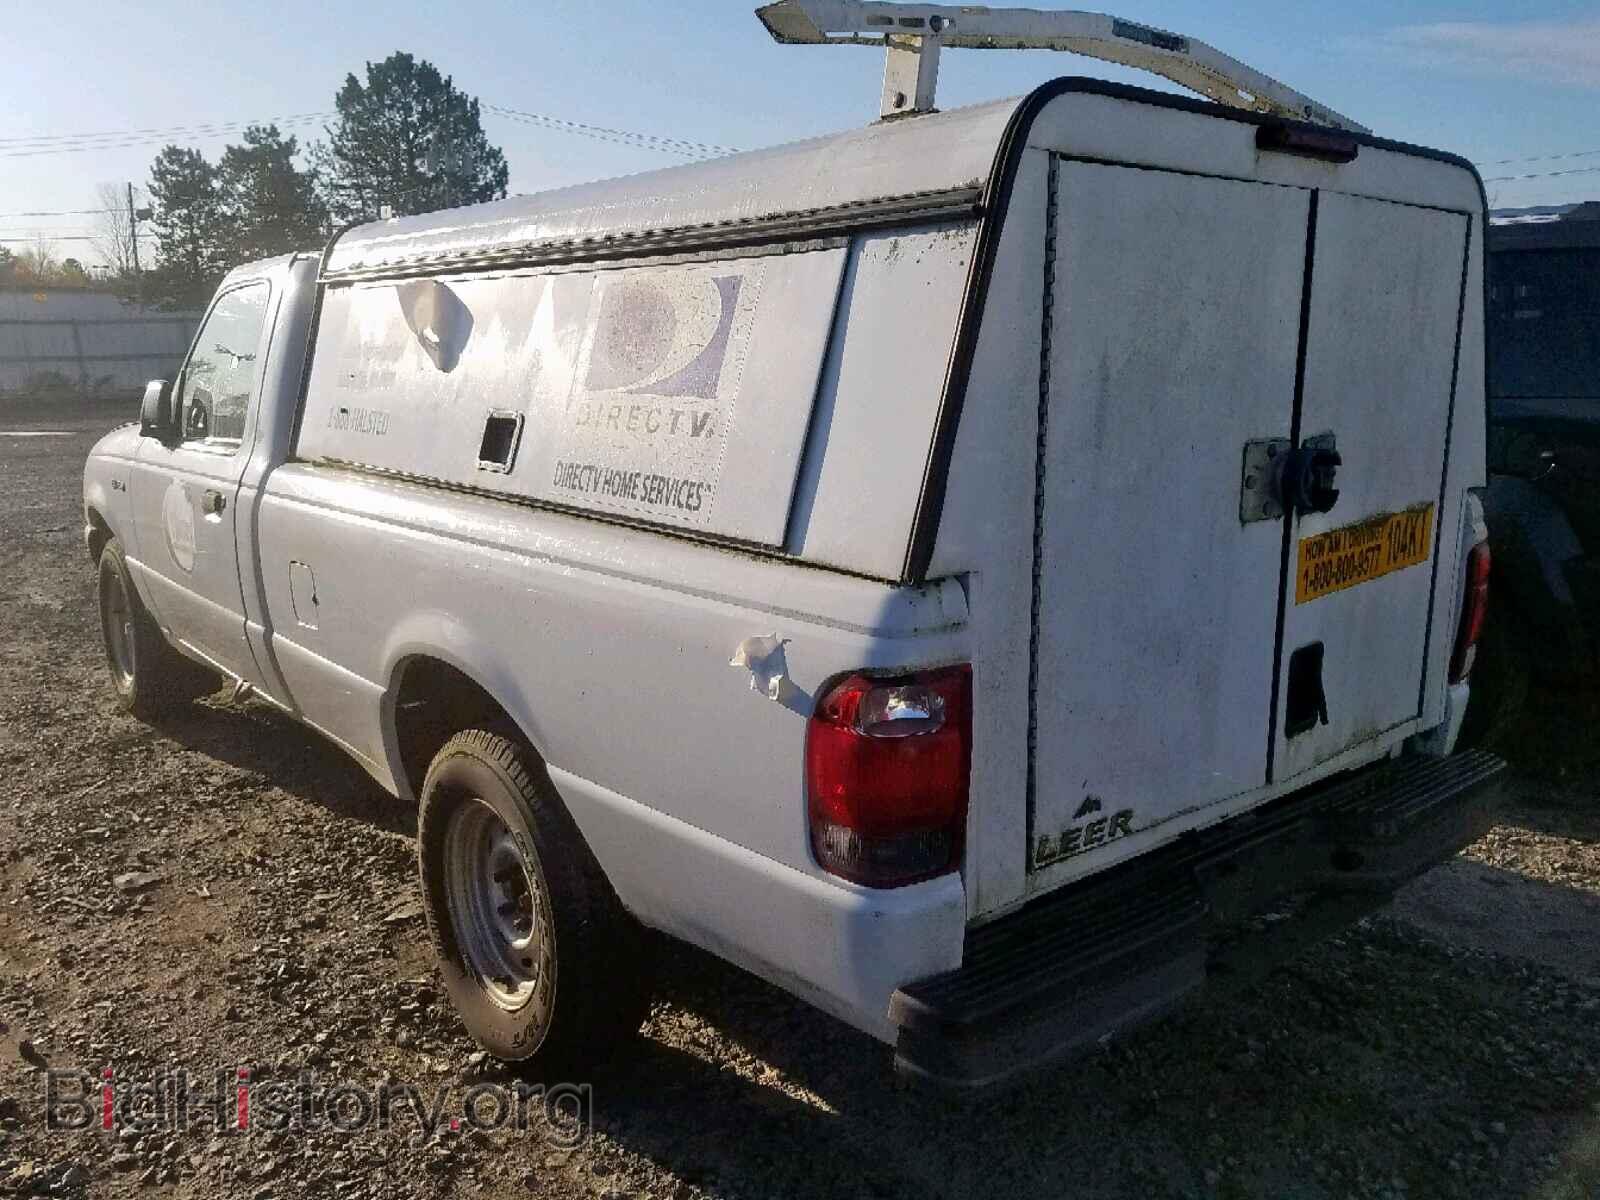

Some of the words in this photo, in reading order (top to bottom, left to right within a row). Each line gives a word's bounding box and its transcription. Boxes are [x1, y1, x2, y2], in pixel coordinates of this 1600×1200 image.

[553, 460, 603, 493] DIRECTV
[602, 467, 640, 500] HOME
[1305, 536, 1325, 561] HOW
[1328, 532, 1341, 554] AM
[1035, 808, 1133, 863] LEER
